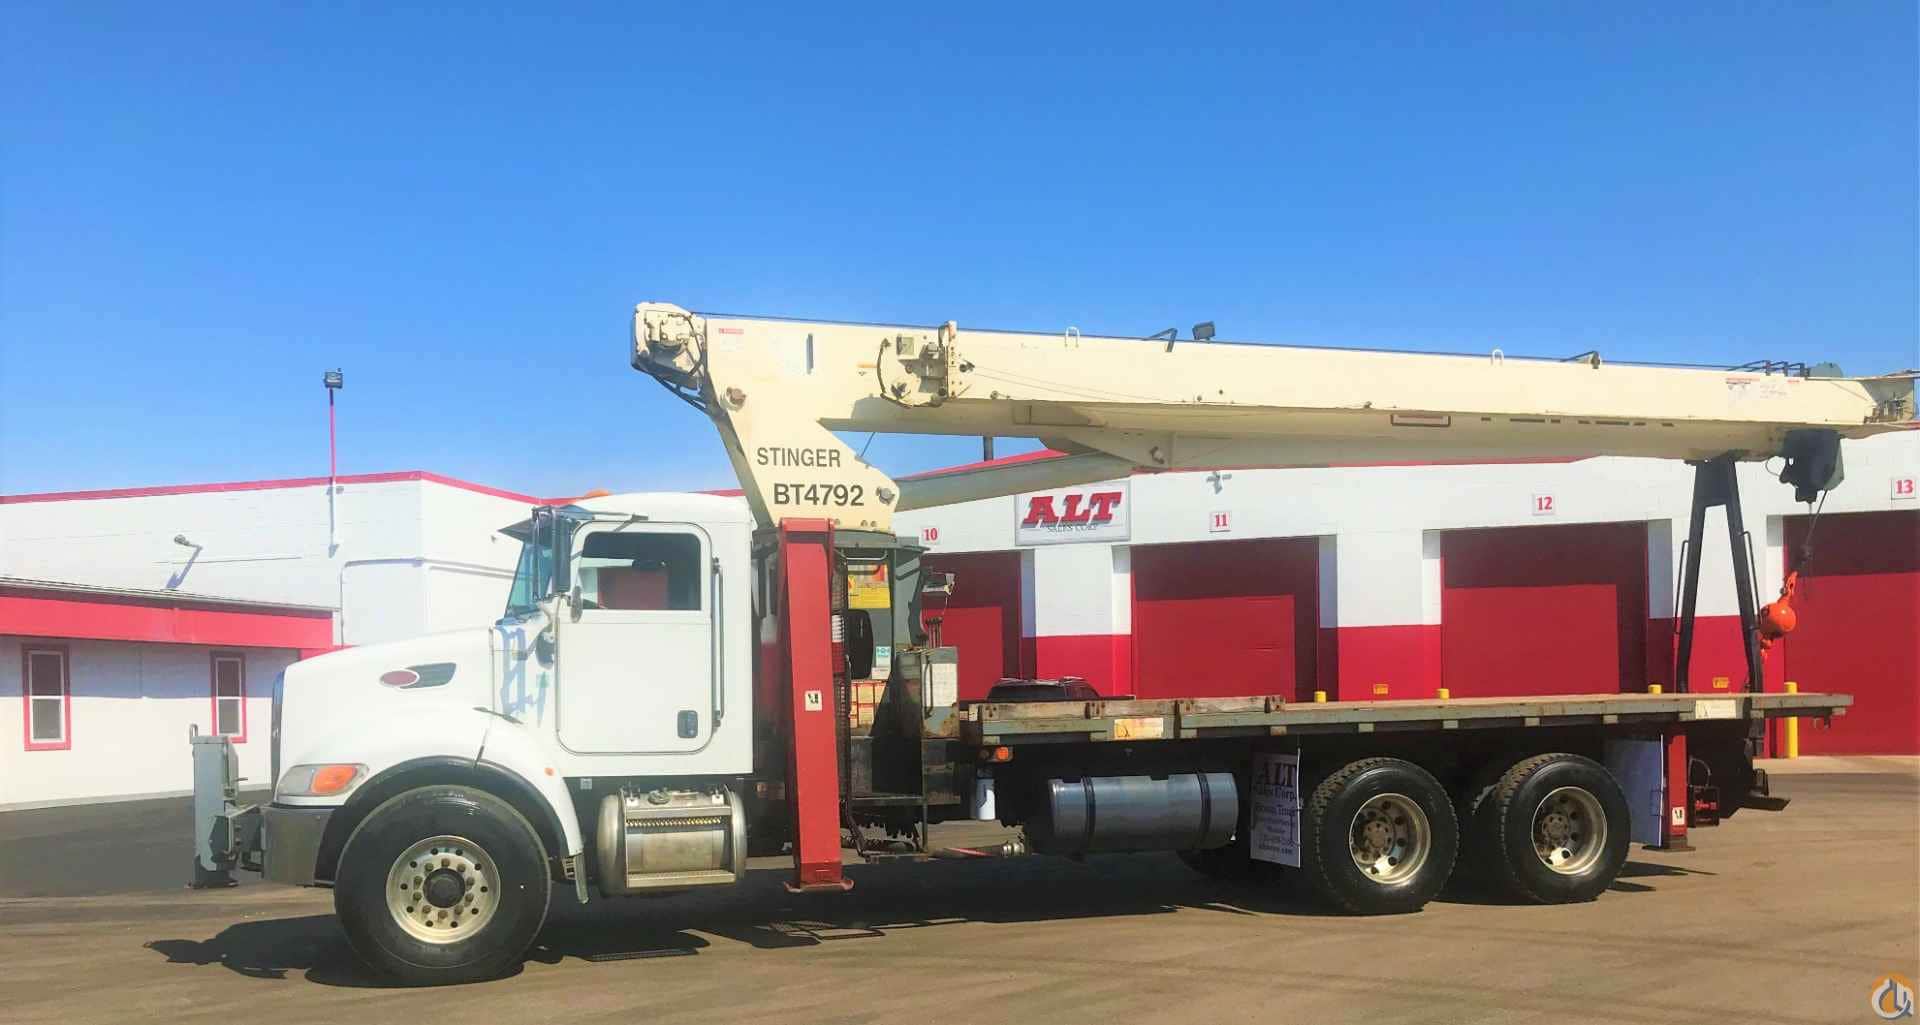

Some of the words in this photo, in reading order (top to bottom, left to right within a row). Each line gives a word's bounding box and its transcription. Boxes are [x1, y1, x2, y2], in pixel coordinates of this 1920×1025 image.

[757, 447, 841, 468] STINGER
[773, 483, 864, 507] BT4792
[1895, 479, 1914, 495] 13
[1022, 491, 1122, 528] ALT
[1537, 496, 1553, 511] 12
[1214, 513, 1228, 527] 11
[923, 527, 938, 541] 10
[1255, 761, 1297, 787] ALT
